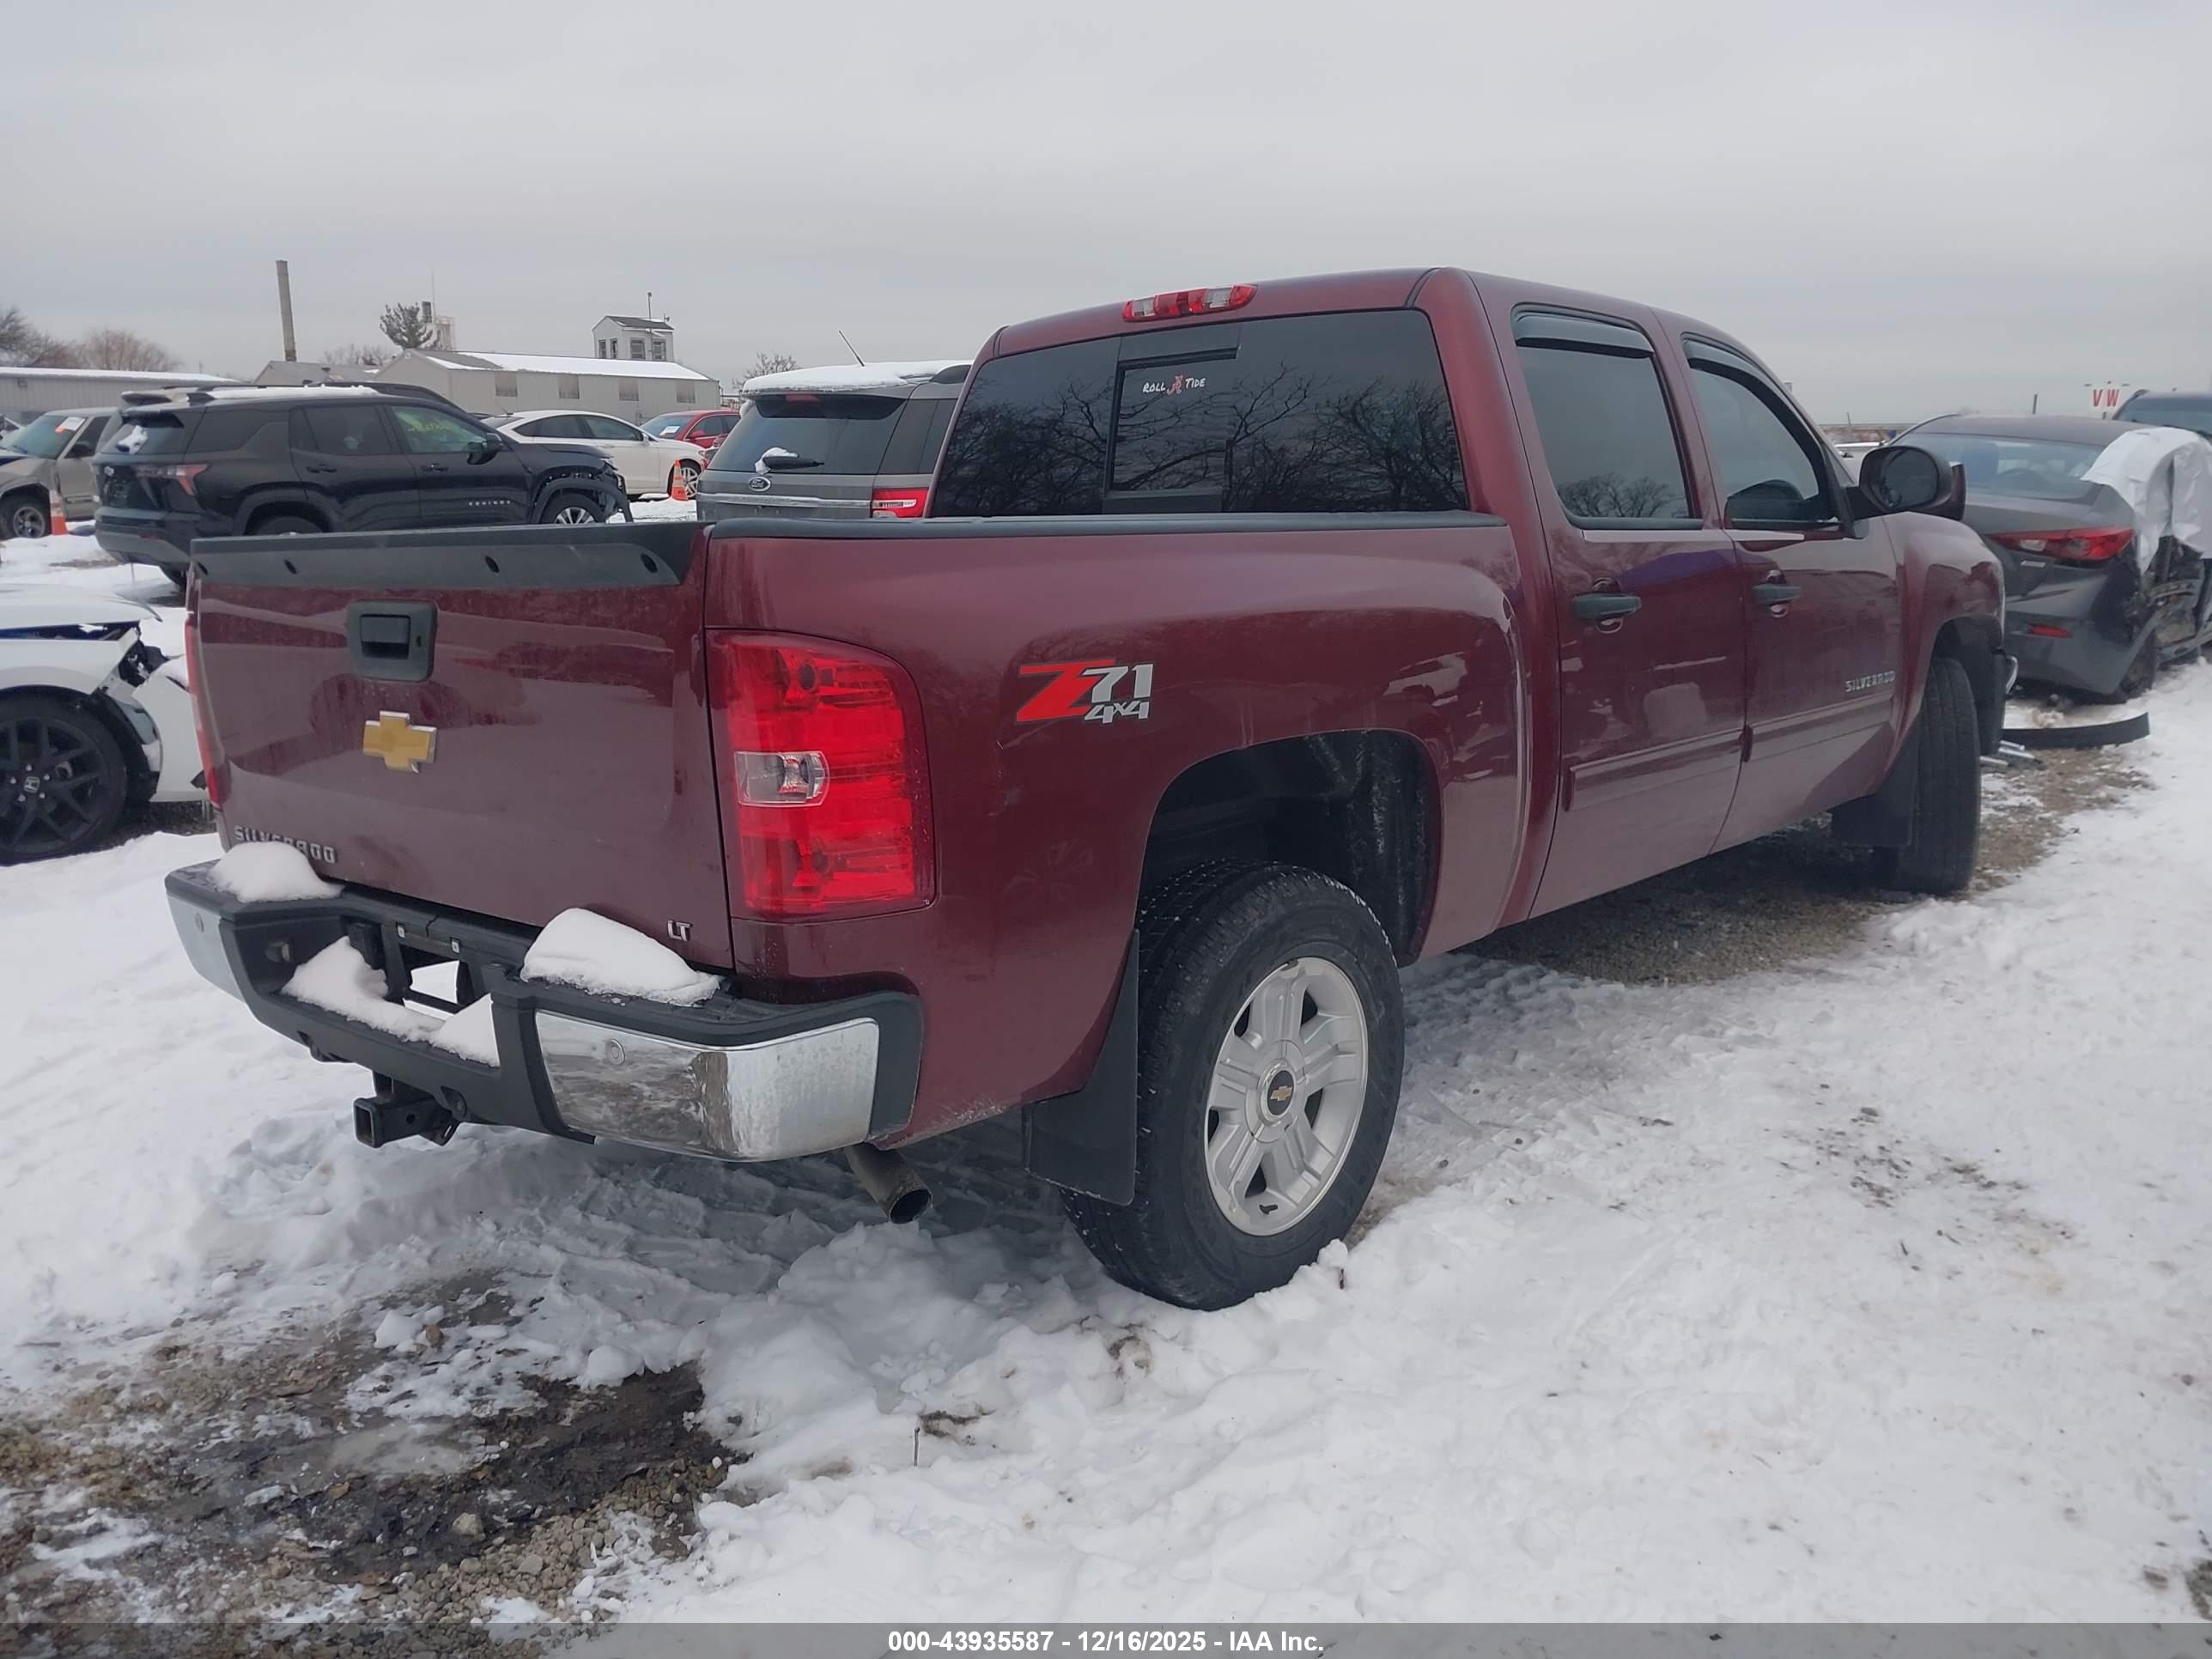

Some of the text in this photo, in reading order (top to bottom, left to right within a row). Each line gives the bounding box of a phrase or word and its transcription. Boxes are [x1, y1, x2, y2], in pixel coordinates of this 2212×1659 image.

[1143, 383, 1166, 393] ROLL
[1185, 378, 1206, 389] TIDE
[1017, 659, 1153, 721] Z71
[1844, 671, 1896, 692] SILVERADO
[667, 920, 690, 942] LT
